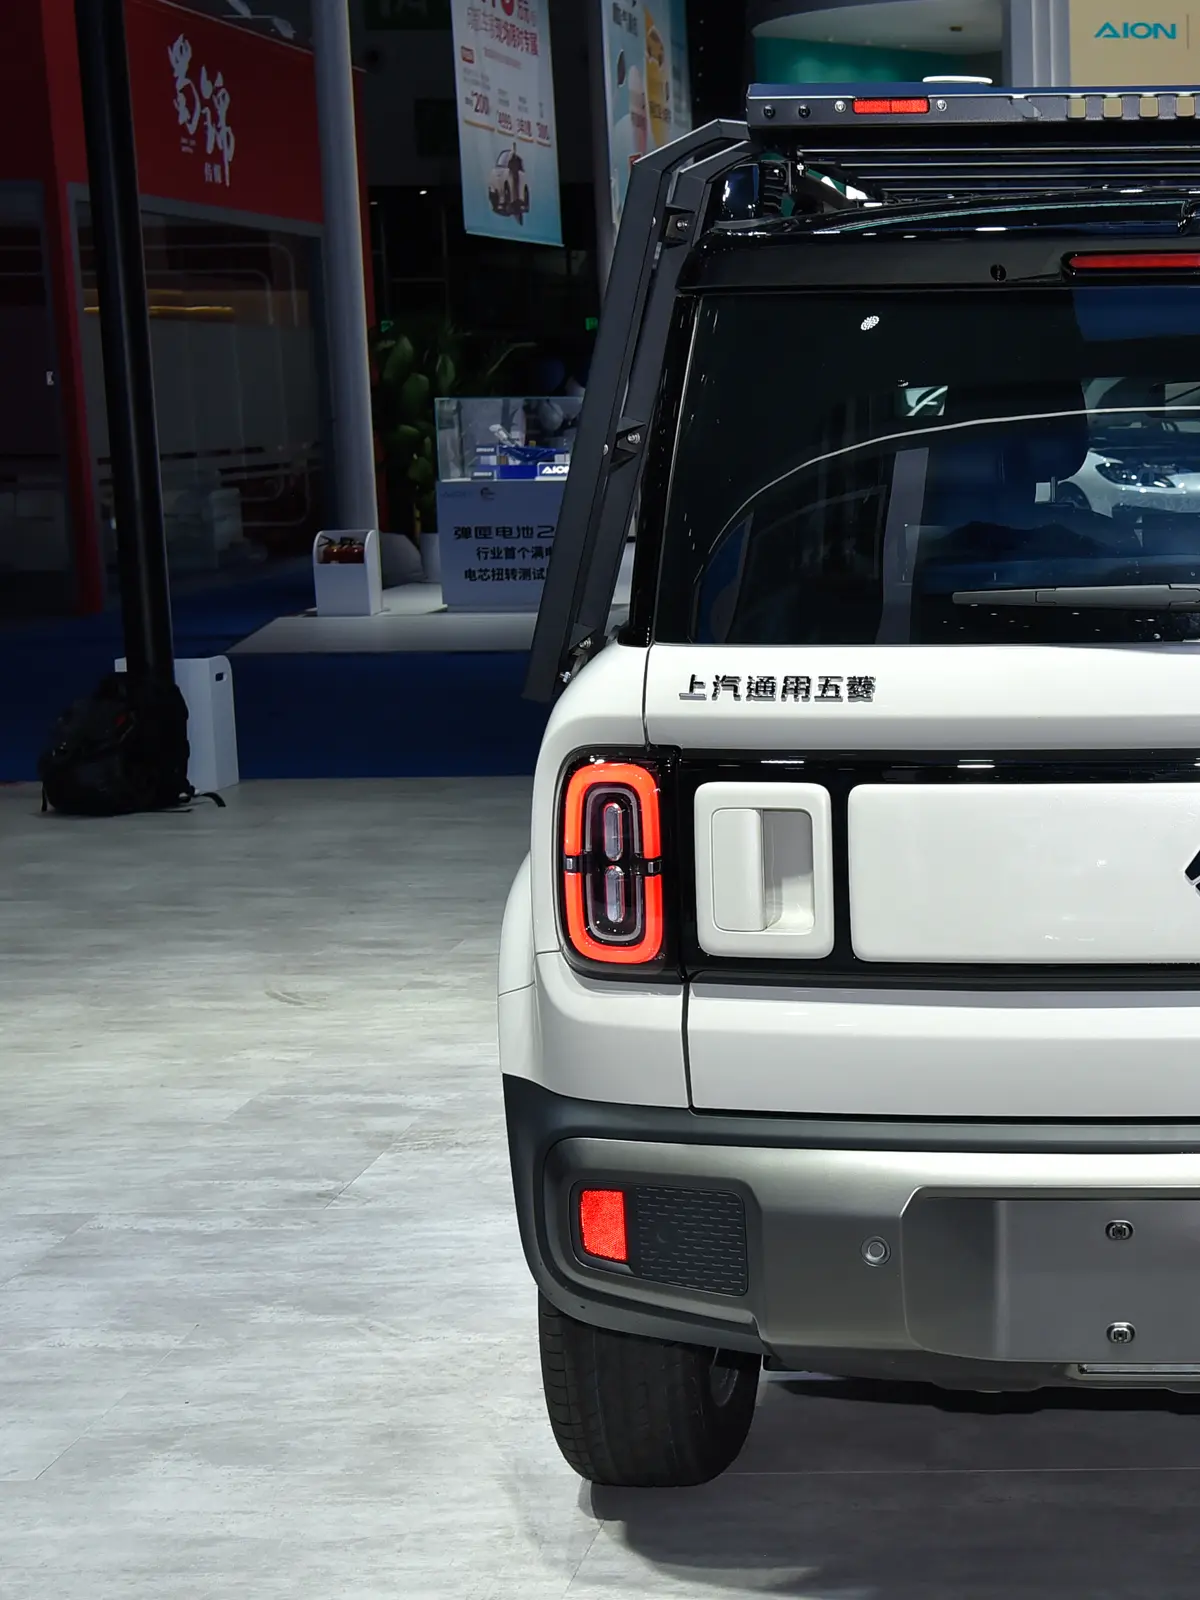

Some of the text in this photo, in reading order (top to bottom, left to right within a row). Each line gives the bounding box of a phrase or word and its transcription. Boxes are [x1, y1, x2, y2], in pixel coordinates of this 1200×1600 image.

[1094, 22, 1177, 40] AION
[464, 567, 548, 582] 电芯扭转测试
[679, 674, 876, 702] 上汽通用五菱
